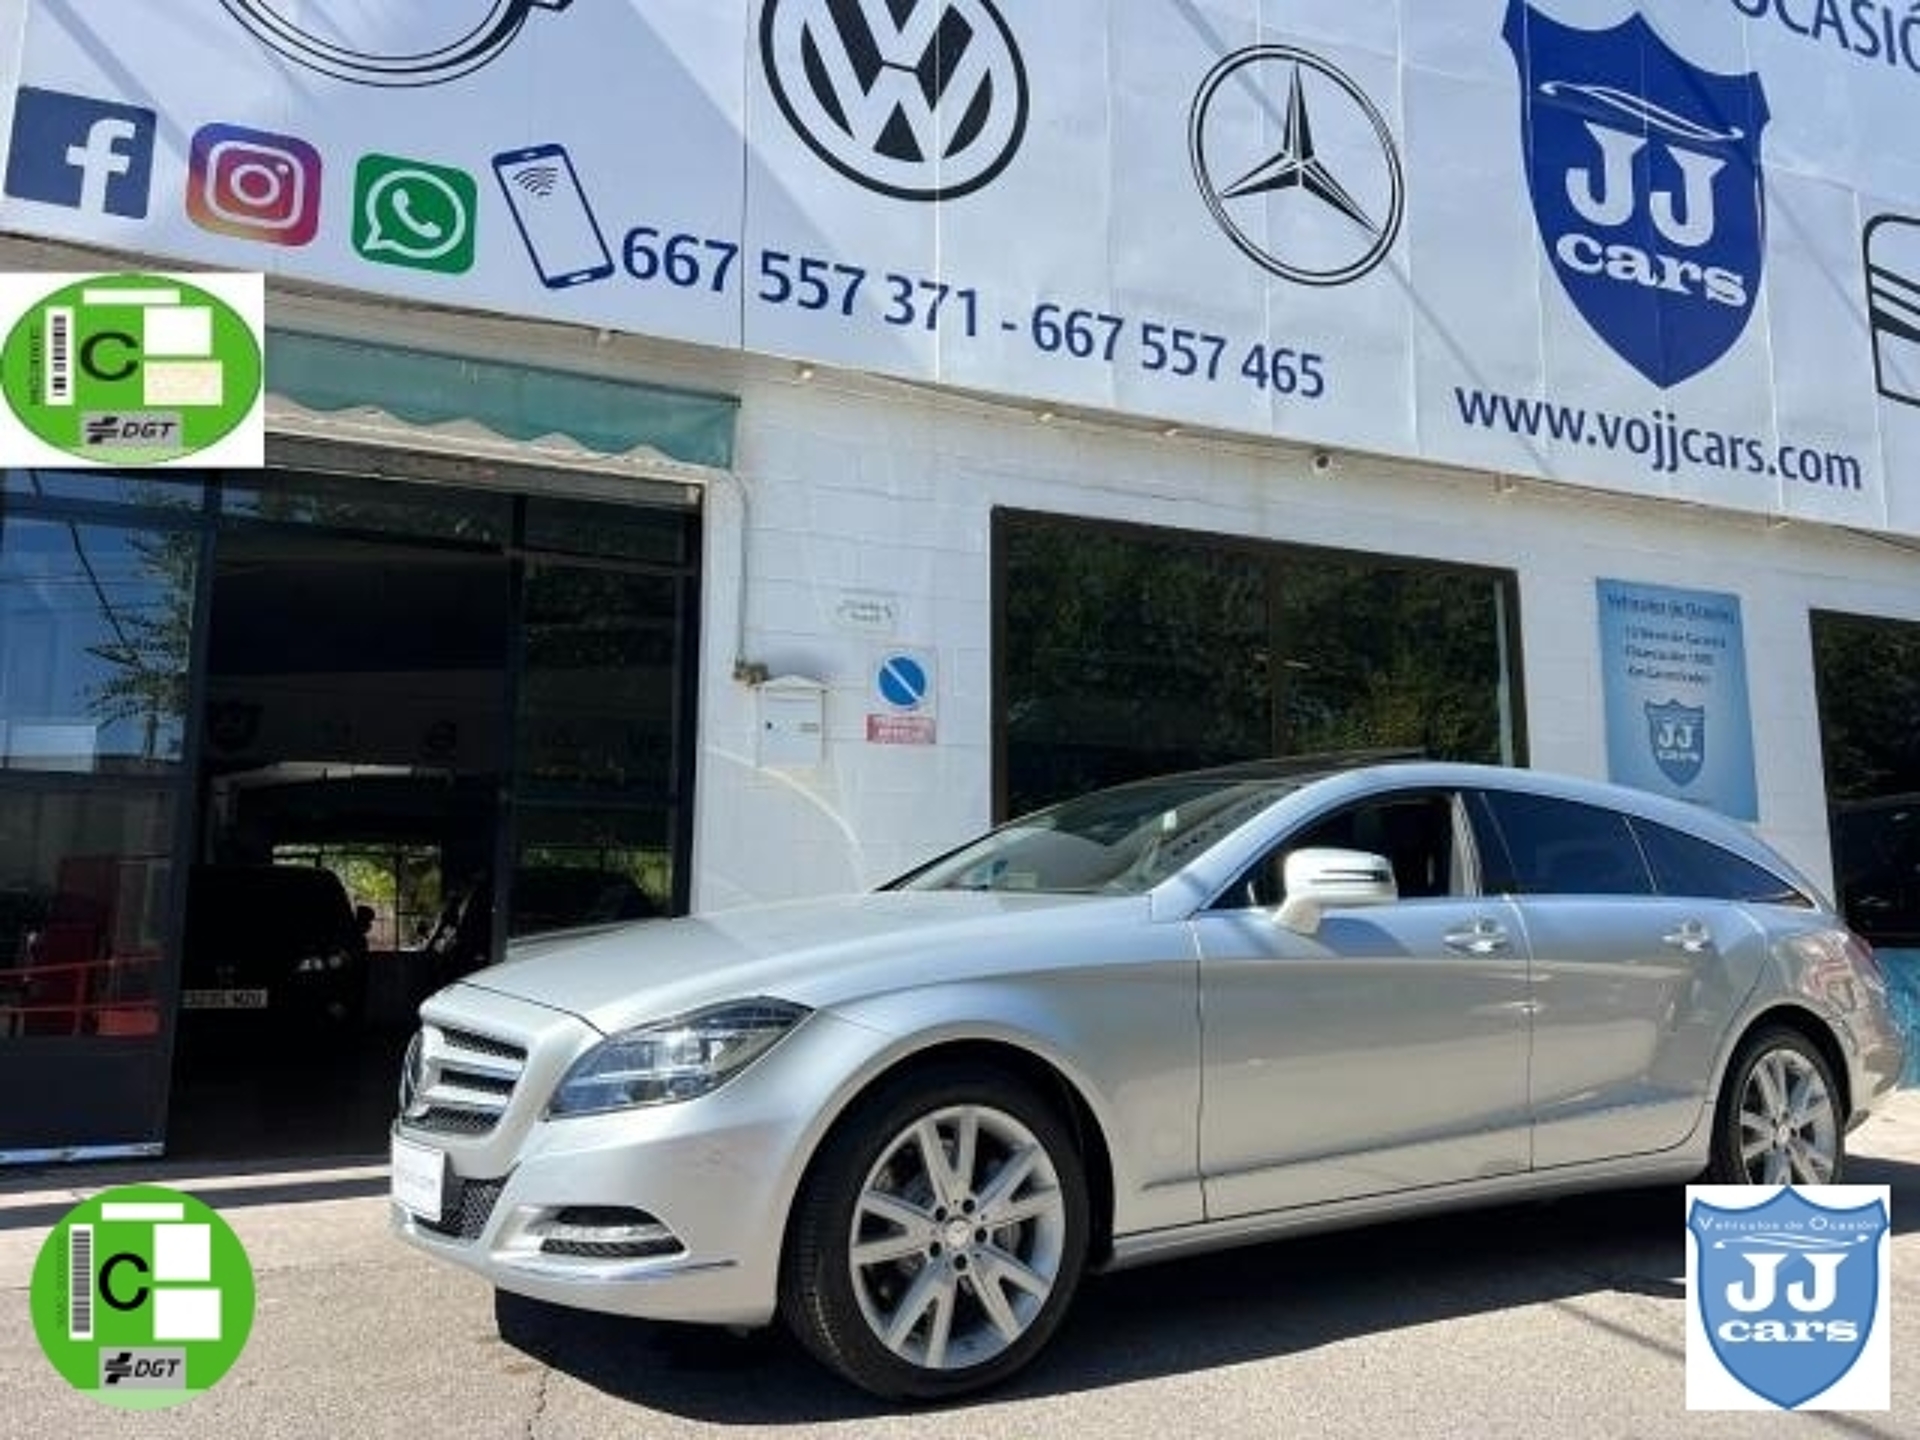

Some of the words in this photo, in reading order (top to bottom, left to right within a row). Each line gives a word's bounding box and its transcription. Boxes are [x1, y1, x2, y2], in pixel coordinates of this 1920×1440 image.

[1565, 119, 1727, 246] JJ
[622, 227, 738, 291] 667
[759, 251, 865, 315] 557
[885, 274, 977, 336] 371
[1032, 303, 1123, 360] 667
[1140, 323, 1226, 380] 557
[1241, 343, 1326, 397] 465
[1556, 233, 1746, 307] cars
[1454, 386, 1862, 489] www.vojjcars.com
